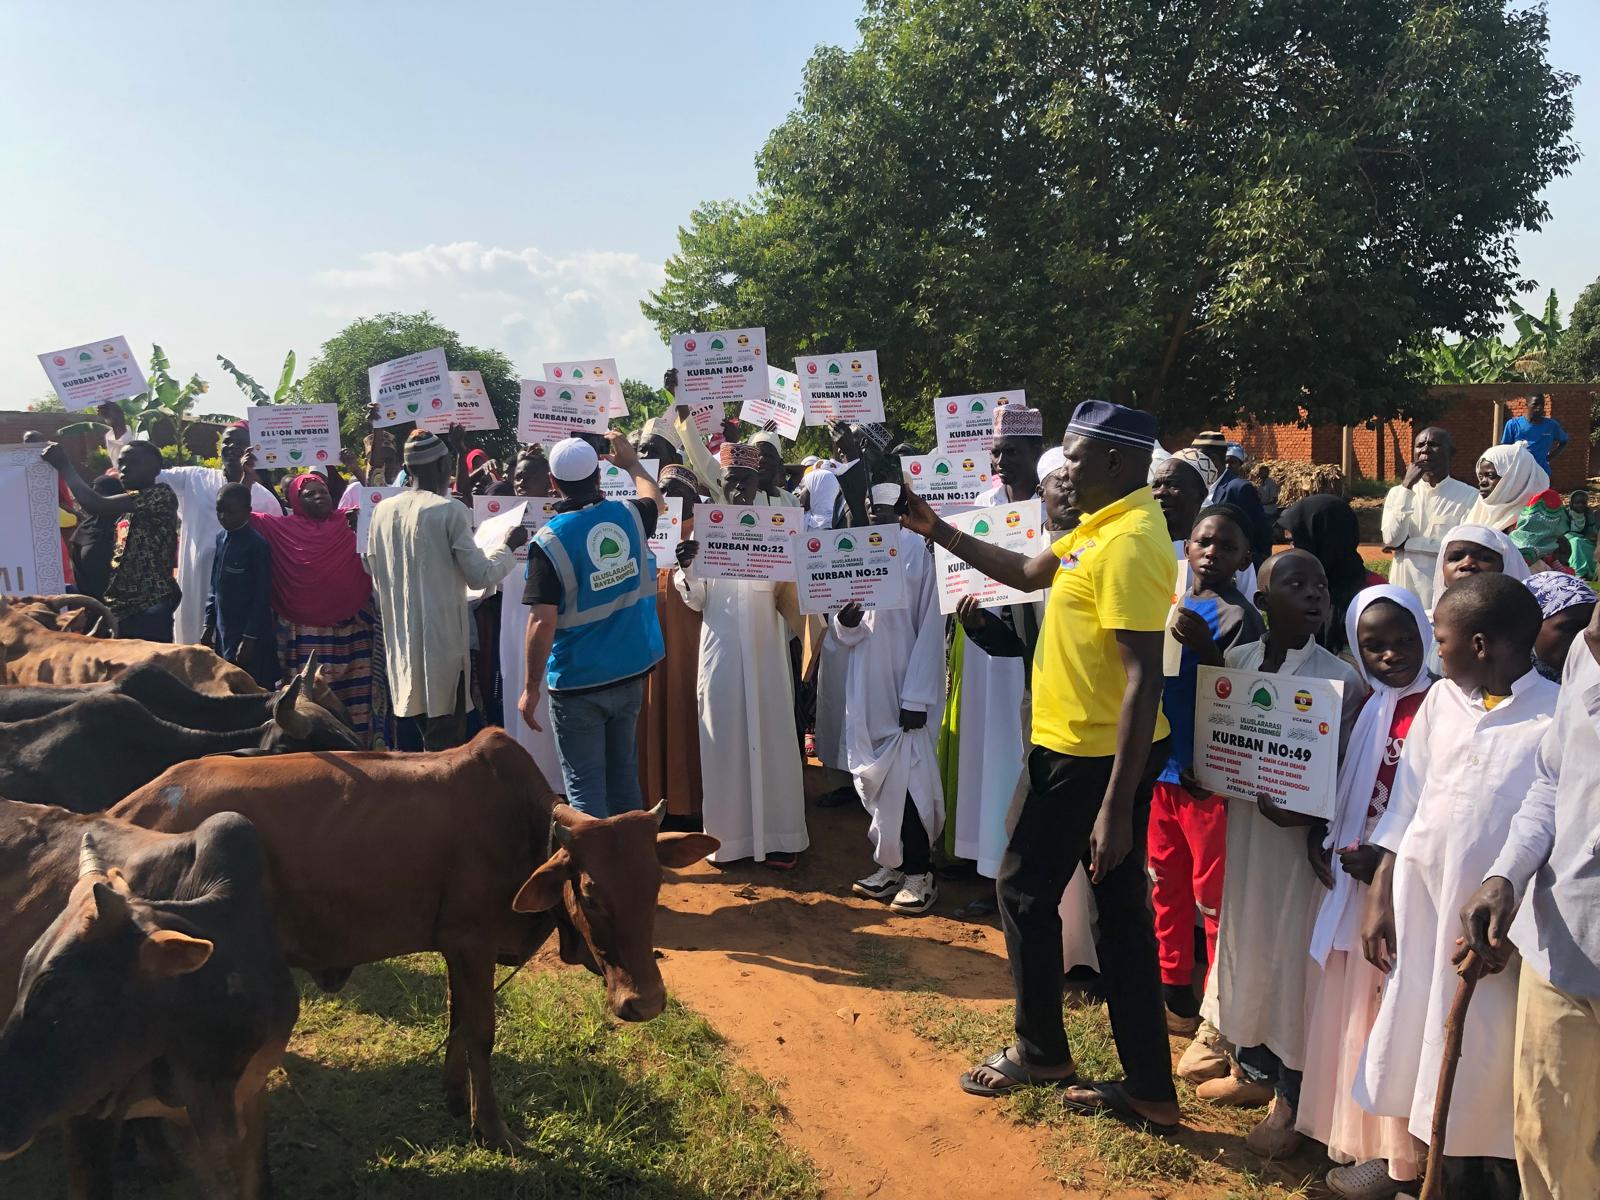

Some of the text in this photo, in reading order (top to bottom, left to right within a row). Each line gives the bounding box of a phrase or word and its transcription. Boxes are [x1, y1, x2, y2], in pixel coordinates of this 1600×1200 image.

[687, 365, 754, 377] KURBAN NO:86
[62, 375, 96, 389] KURBAN
[97, 367, 128, 379] NO:117
[409, 374, 441, 388] KURBAN
[811, 391, 841, 399] KURBAN
[691, 404, 714, 416] O:119
[533, 412, 596, 426] KURBAN NO:89
[294, 428, 329, 436] KURBAN
[949, 429, 983, 439] KURBAN
[916, 493, 945, 501] RBAN
[708, 542, 784, 553] KURBAN NO:22
[811, 567, 889, 581] KURBAN NO:25
[947, 562, 974, 574] KURB
[593, 577, 616, 589] RAVZA
[1240, 716, 1282, 730] ULUSLARARASI
[1240, 724, 1257, 733] RAVZA
[1212, 730, 1312, 762] KURBAN NO:49
